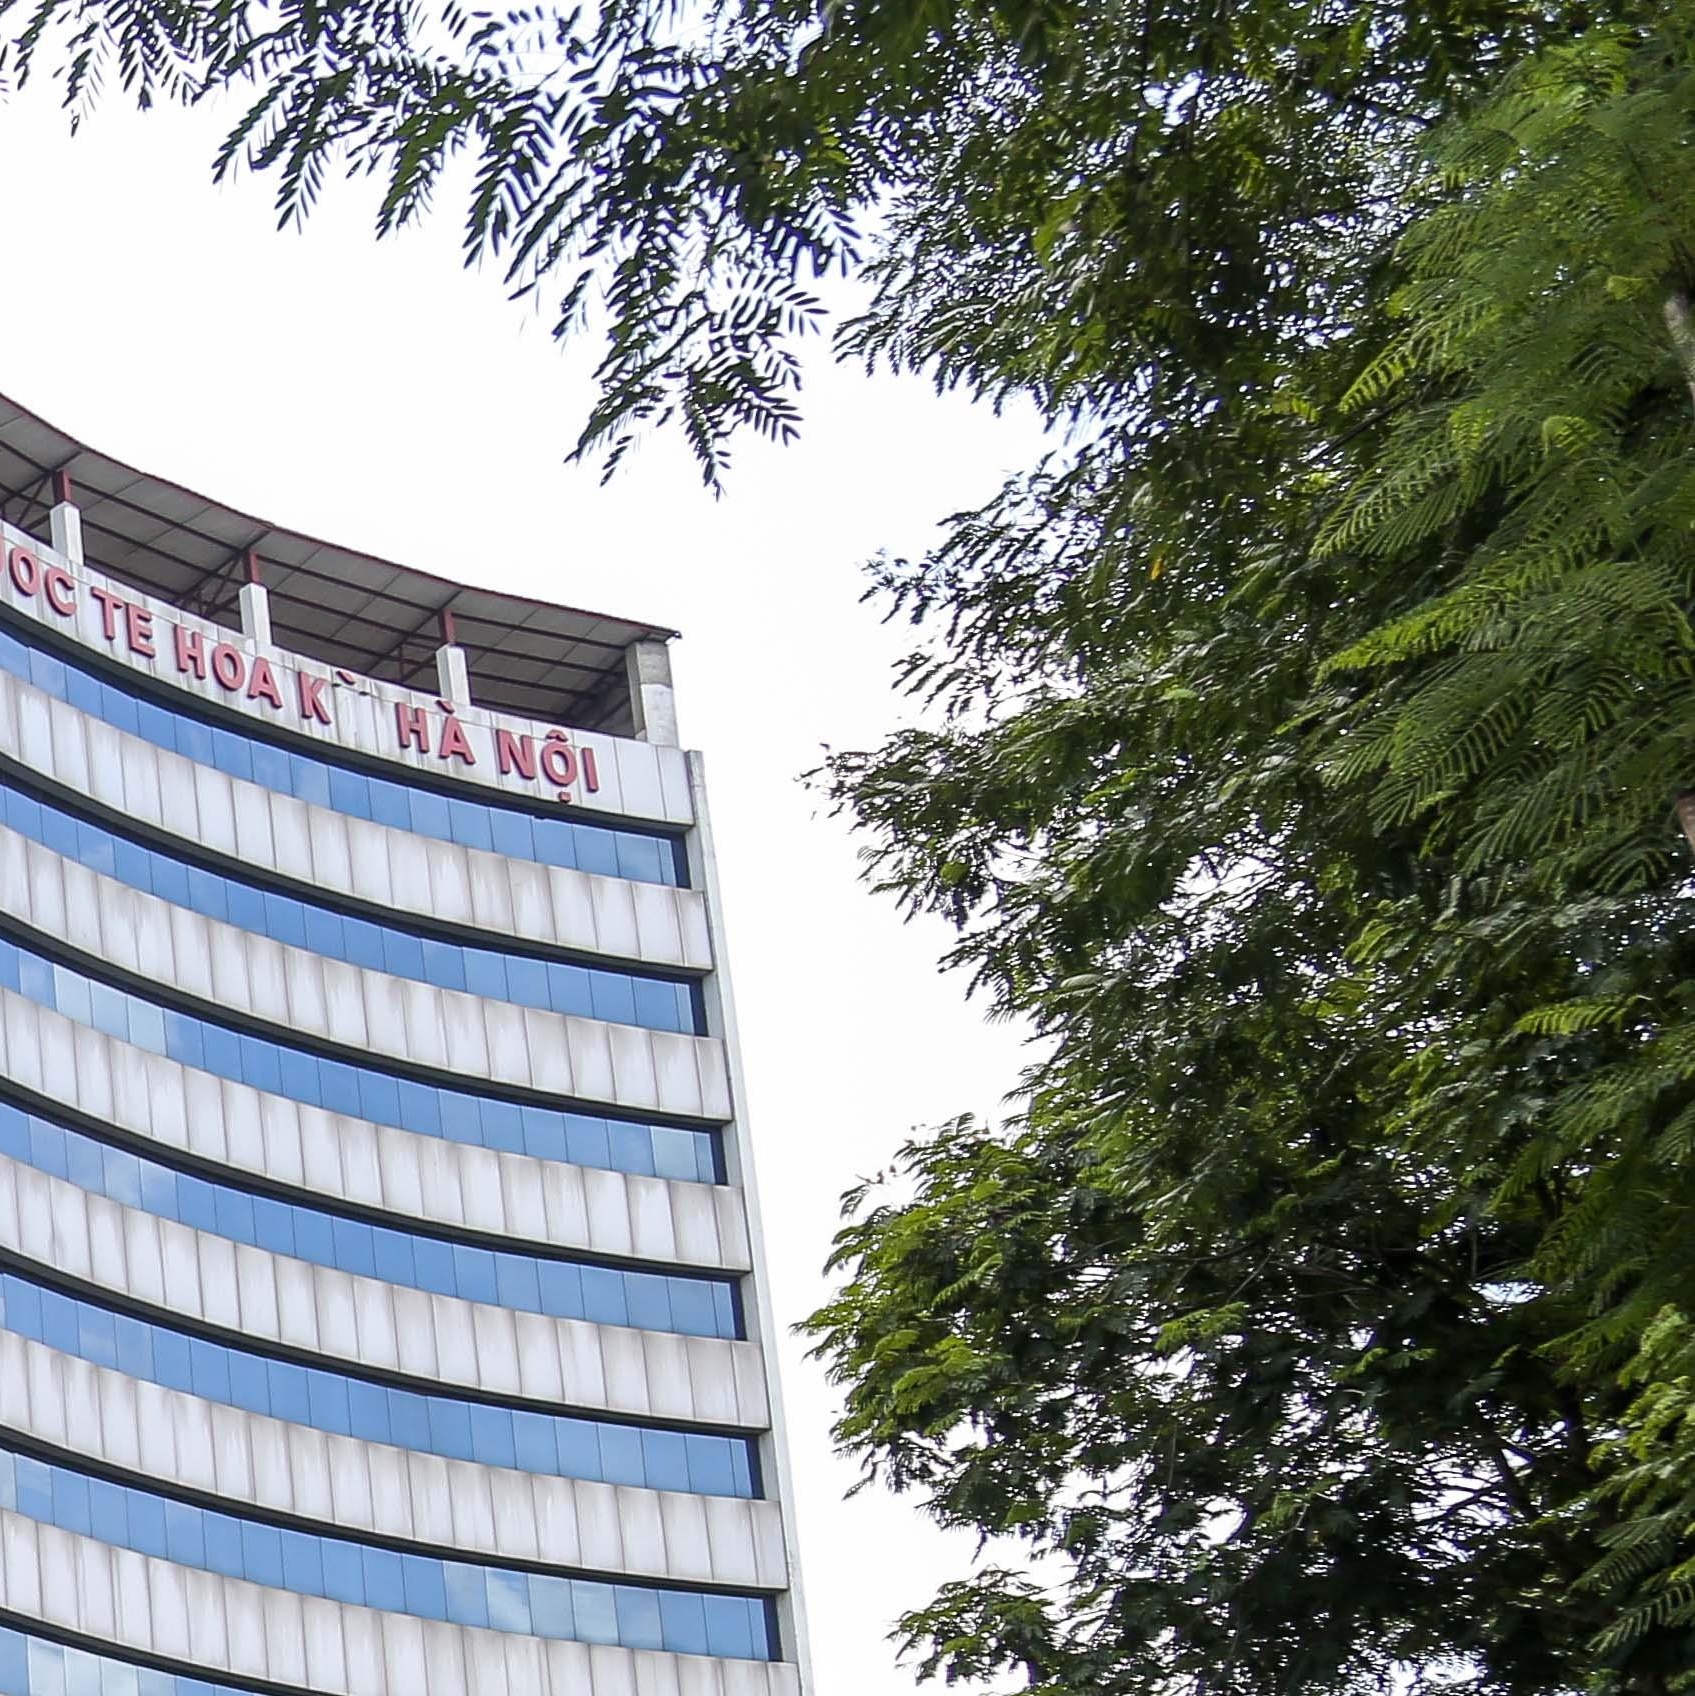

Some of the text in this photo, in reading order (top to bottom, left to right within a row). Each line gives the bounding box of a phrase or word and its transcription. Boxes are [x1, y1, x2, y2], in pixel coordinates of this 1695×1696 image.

[173, 623, 284, 710] HOA
[395, 699, 477, 766] HÀ
[496, 728, 599, 804] NỘI
